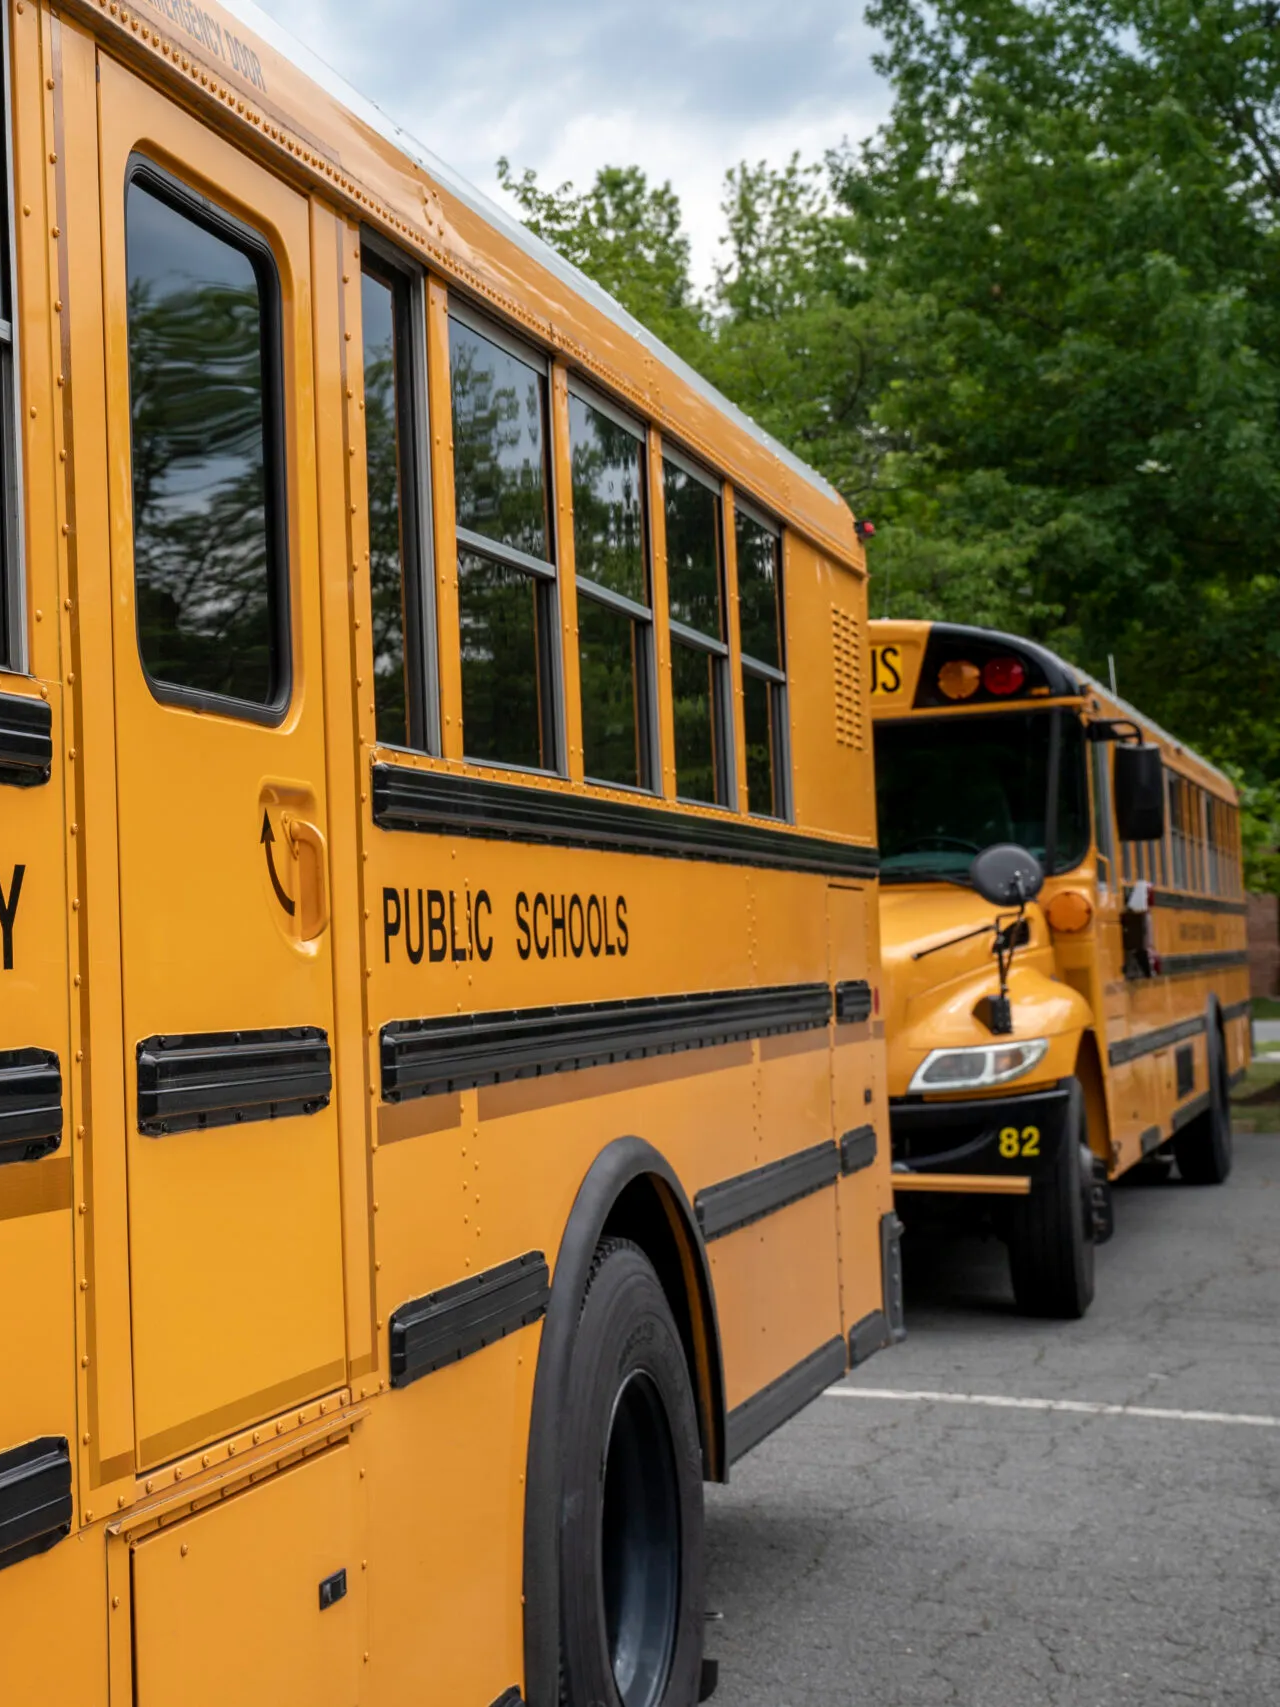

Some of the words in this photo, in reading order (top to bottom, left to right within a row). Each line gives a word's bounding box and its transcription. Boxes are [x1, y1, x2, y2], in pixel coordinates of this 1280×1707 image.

[224, 28, 267, 94] DOOR
[382, 887, 493, 965] PUBLIC
[515, 891, 629, 960] SCHOOLS
[999, 1125, 1040, 1158] 82
